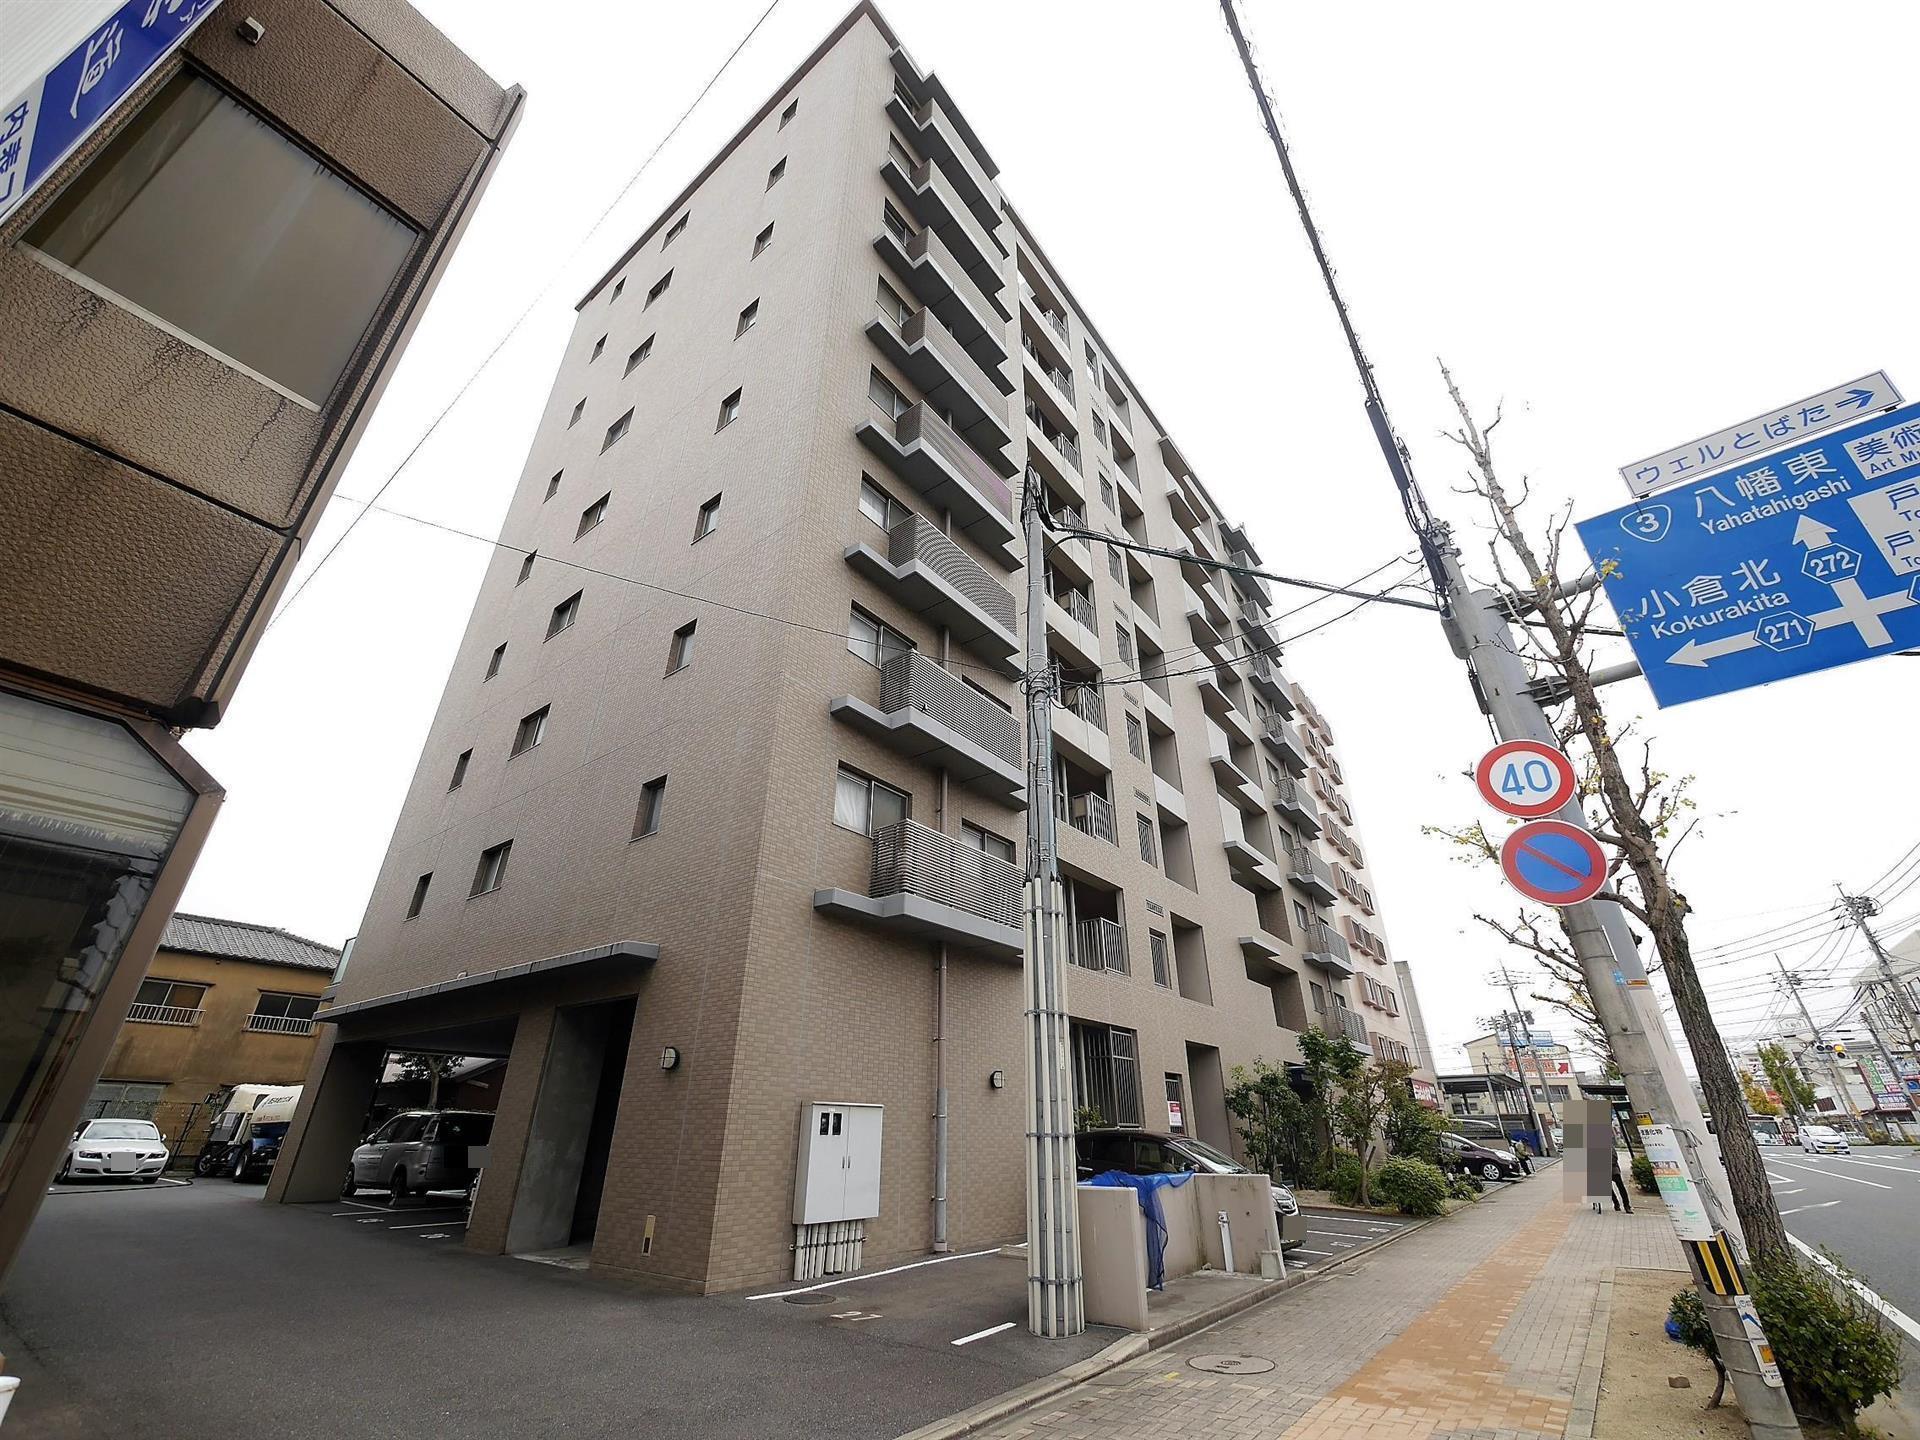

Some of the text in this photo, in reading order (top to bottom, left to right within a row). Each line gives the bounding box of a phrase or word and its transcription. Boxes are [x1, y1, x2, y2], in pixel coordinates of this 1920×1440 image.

[1869, 450, 1920, 474] Art M
[1695, 448, 1837, 518] 八幡東
[1636, 512, 1660, 534] 3
[1700, 476, 1852, 535] Yahatahigashi
[1809, 551, 1855, 578] 272
[1641, 558, 1781, 619] 小倉北
[1650, 590, 1790, 639] Kokurakita
[1763, 618, 1807, 645] 271
[1501, 759, 1553, 796] 40
